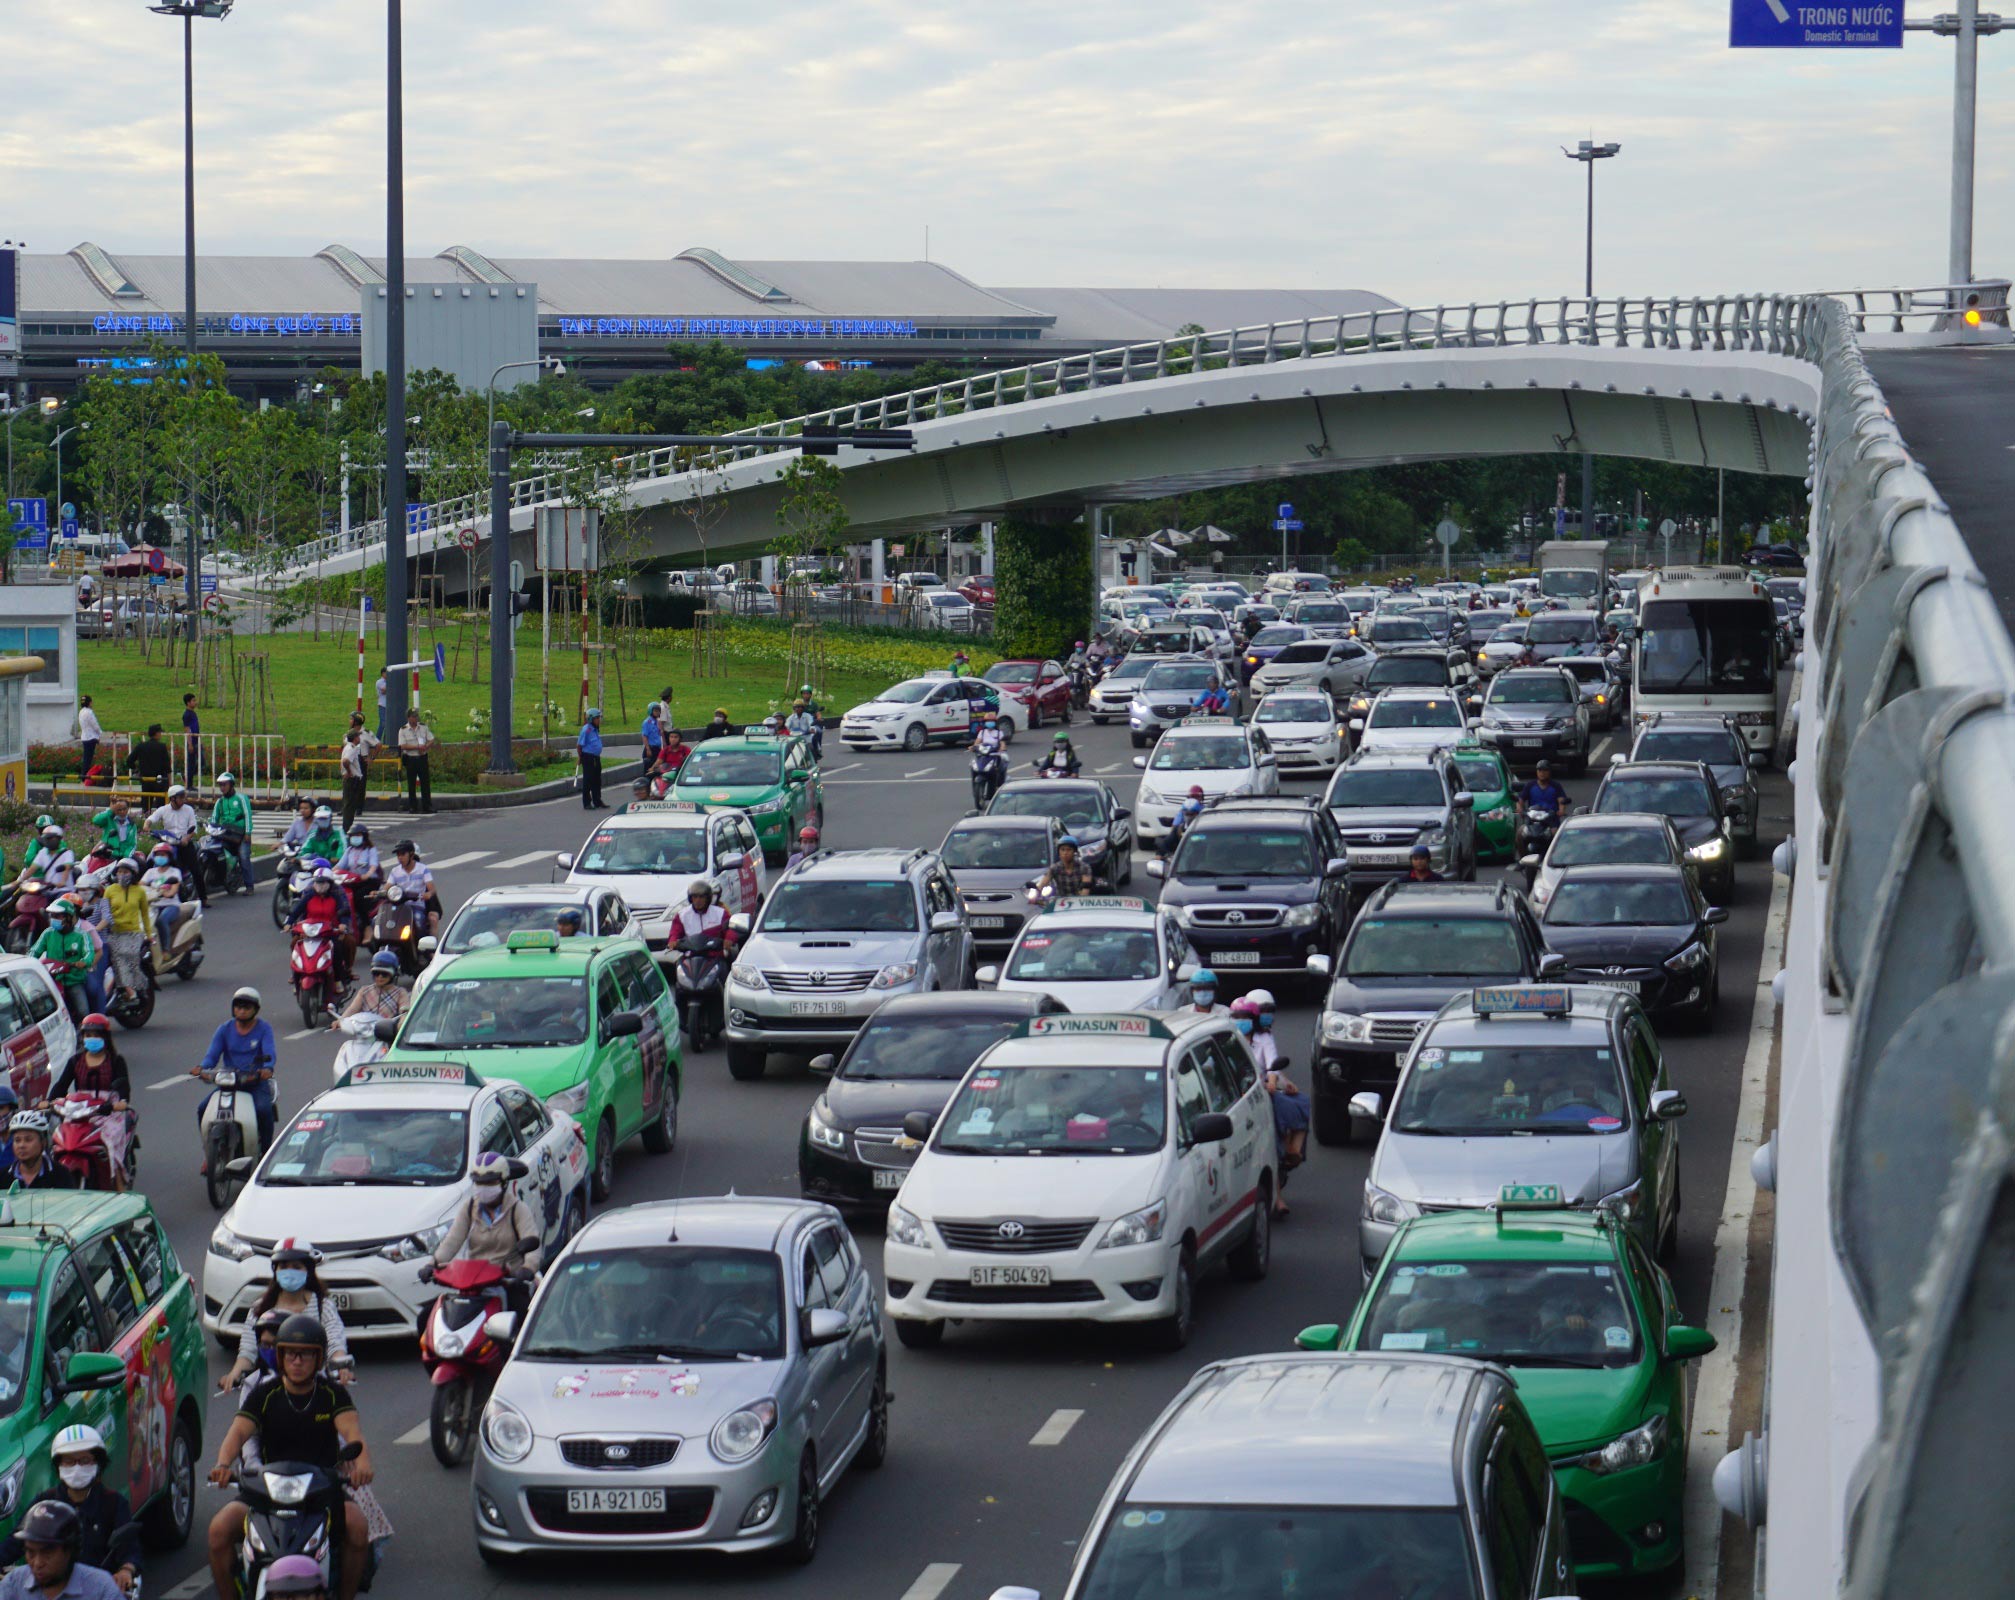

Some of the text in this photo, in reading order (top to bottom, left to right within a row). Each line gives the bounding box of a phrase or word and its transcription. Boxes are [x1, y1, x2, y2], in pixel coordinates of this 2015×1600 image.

[1798, 4, 1893, 25] TRONG NƯỚC
[1805, 29, 1879, 42] Domestic Terminal
[93, 312, 142, 330] CẢNG
[275, 312, 324, 334] QUỐC
[329, 312, 352, 331] TẾ
[559, 318, 917, 333] TAN SON NHAT INTERNATIONAL TERMINAL
[643, 802, 694, 810] VINASUN TAXI
[1079, 899, 1142, 908] VINASUN TAXI
[1059, 1020, 1146, 1032] VINASUN TAXI
[381, 1067, 464, 1080] VINASUN TAXI
[608, 1447, 626, 1456] KIA
